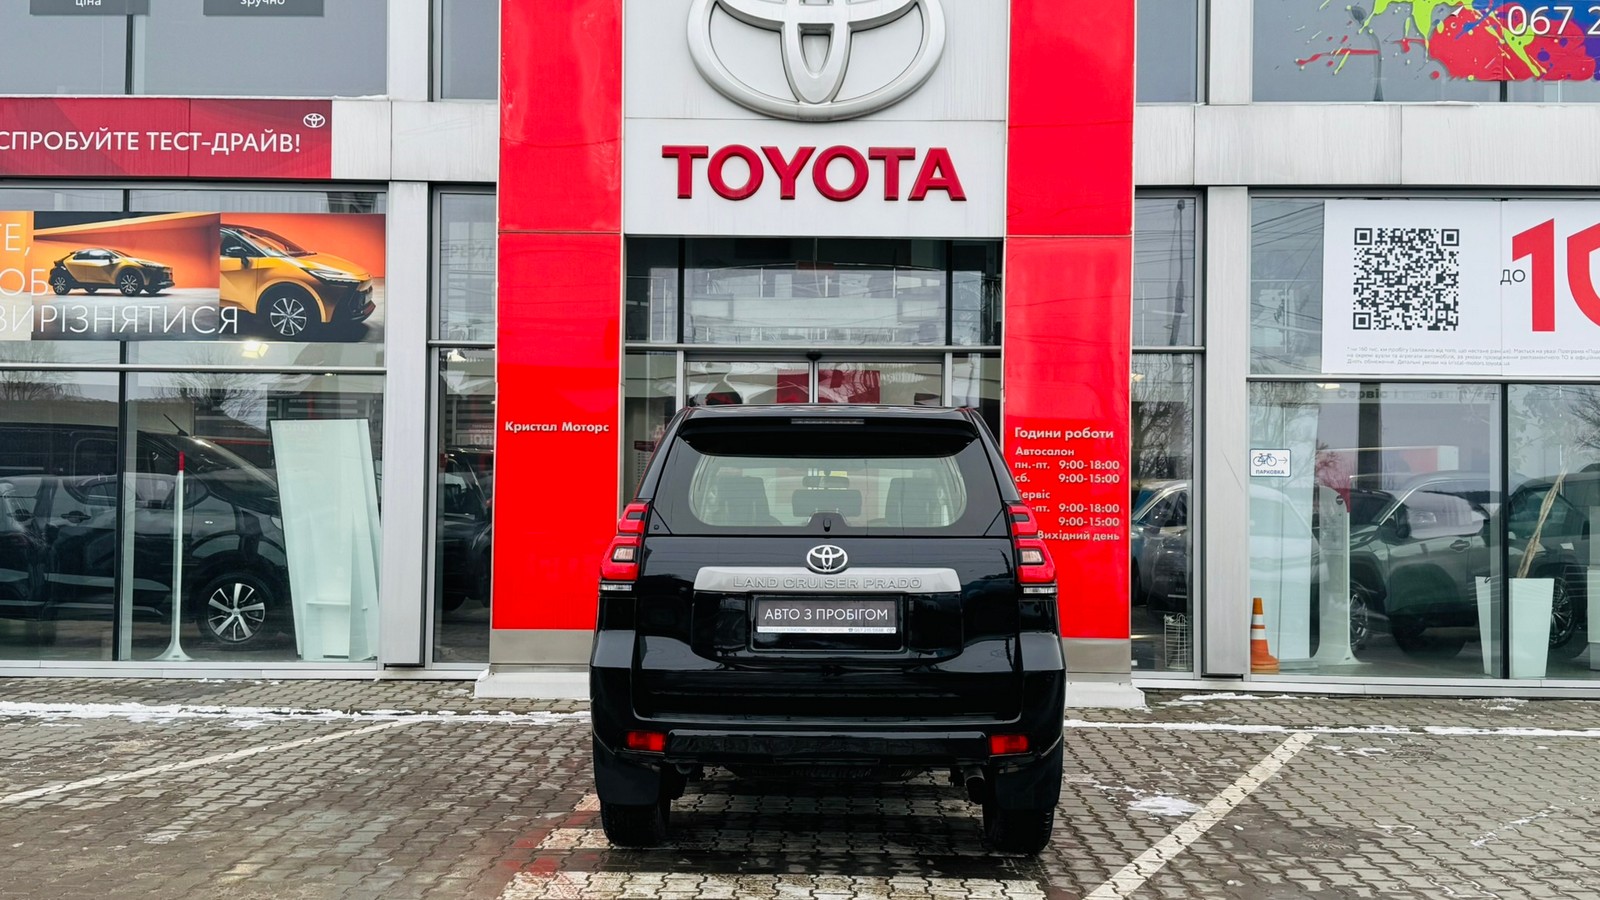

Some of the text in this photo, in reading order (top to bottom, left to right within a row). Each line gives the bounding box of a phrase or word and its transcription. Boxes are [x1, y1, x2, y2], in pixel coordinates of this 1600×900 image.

[1507, 6, 1573, 35] 067
[0, 127, 301, 156] СПРОБУЙТЕ ТЕСТ-ДРАЙВ!
[661, 145, 967, 203] TOYOTA
[505, 421, 557, 434] Кристал
[561, 421, 609, 434] Моторс
[1014, 426, 1114, 440] Години роботи
[1015, 446, 1075, 456] Автосалон
[1015, 461, 1050, 470] пн.-пт.
[1015, 473, 1031, 483] сб.
[1037, 530, 1120, 542] Вихідний день
[733, 576, 922, 590] LAND CRUISER PRADO
[764, 608, 800, 620] АВТО
[816, 608, 888, 620] ПРОБІГОМ
